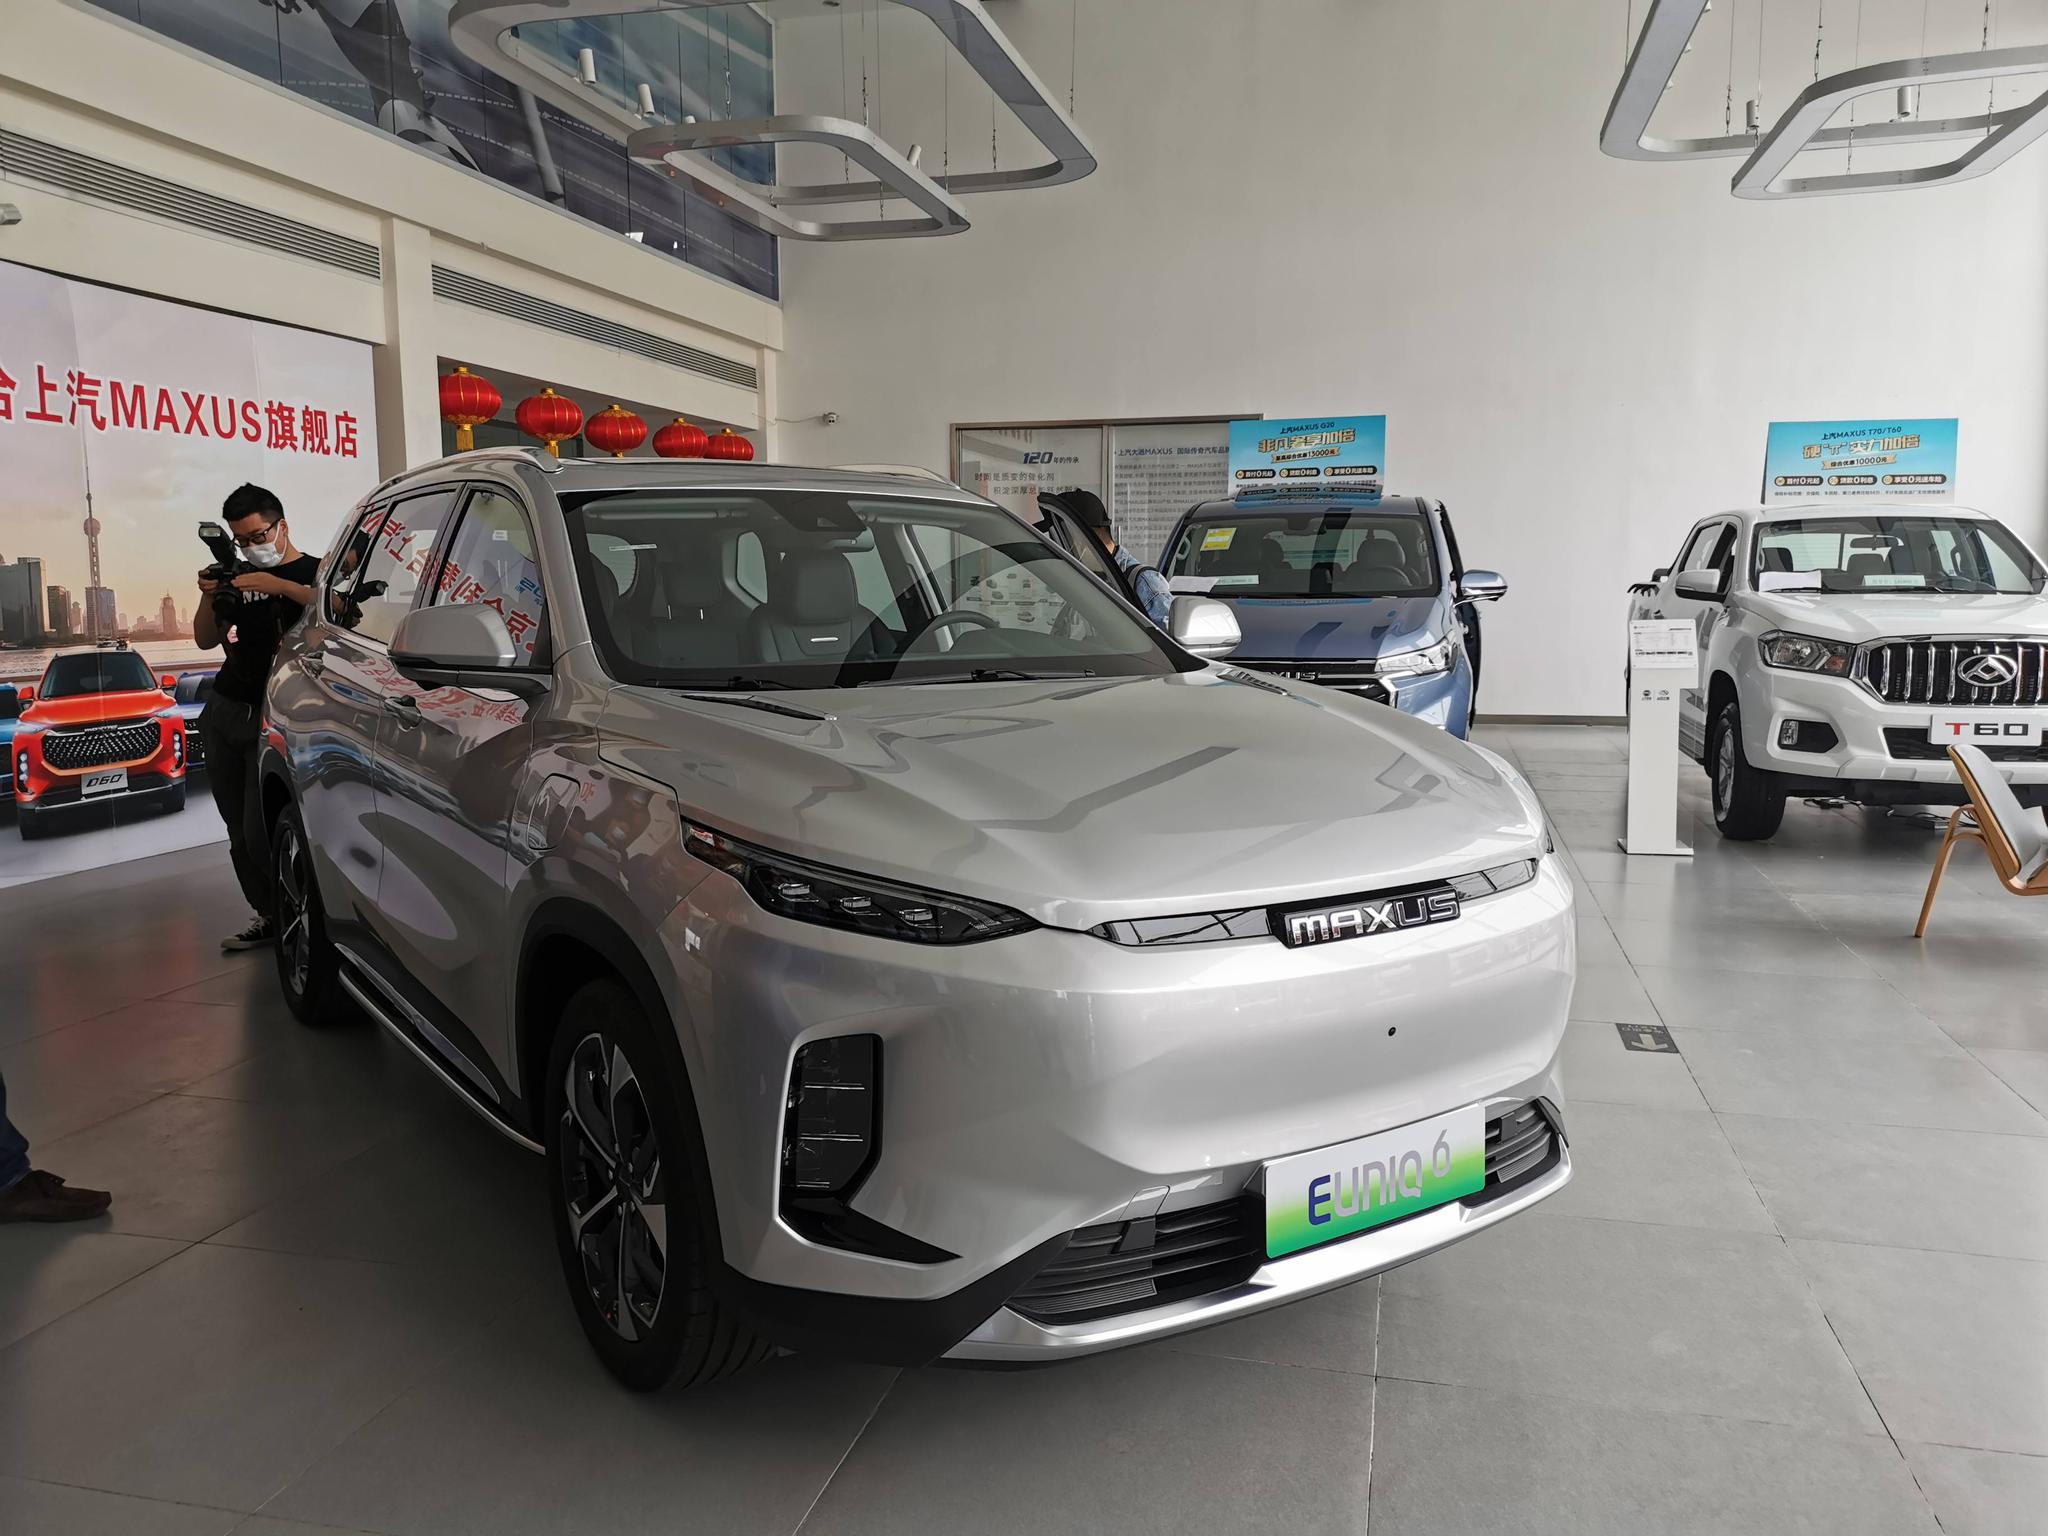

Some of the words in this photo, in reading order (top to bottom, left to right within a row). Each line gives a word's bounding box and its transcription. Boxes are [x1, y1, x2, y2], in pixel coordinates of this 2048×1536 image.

[1822, 430, 1866, 440] 上汽MAXUS
[1869, 426, 1902, 435] T70/T60
[1945, 723, 2029, 736] T60
[86, 773, 124, 788] D60
[1291, 892, 1457, 945] MAXUS
[1308, 1150, 1423, 1226] EUNIQ
[1432, 1129, 1451, 1178] 6
